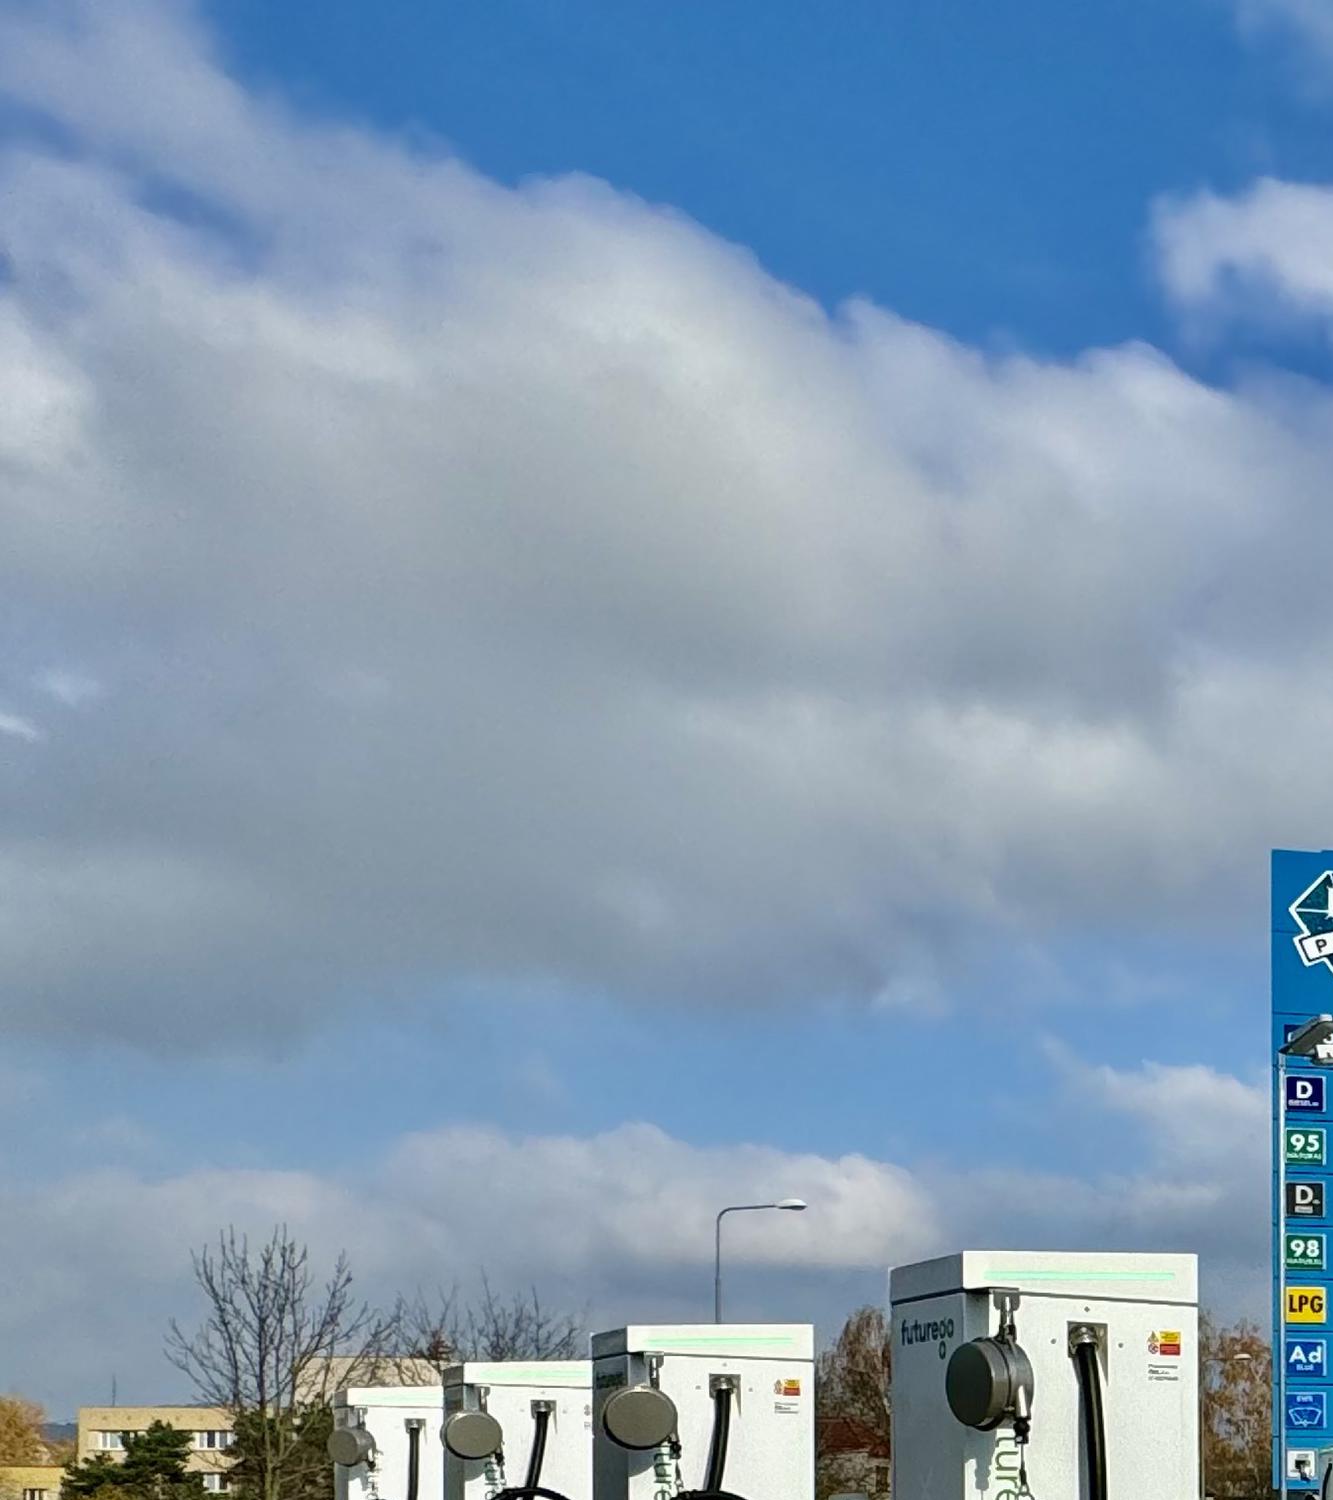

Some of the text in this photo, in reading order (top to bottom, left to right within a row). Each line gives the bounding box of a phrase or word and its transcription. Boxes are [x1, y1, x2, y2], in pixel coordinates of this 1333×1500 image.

[1296, 1081, 1313, 1099] D
[1290, 1134, 1320, 1153] 95
[1290, 1239, 1320, 1258] 98
[1288, 1294, 1324, 1313] LPG
[1288, 1345, 1322, 1363] Ad
